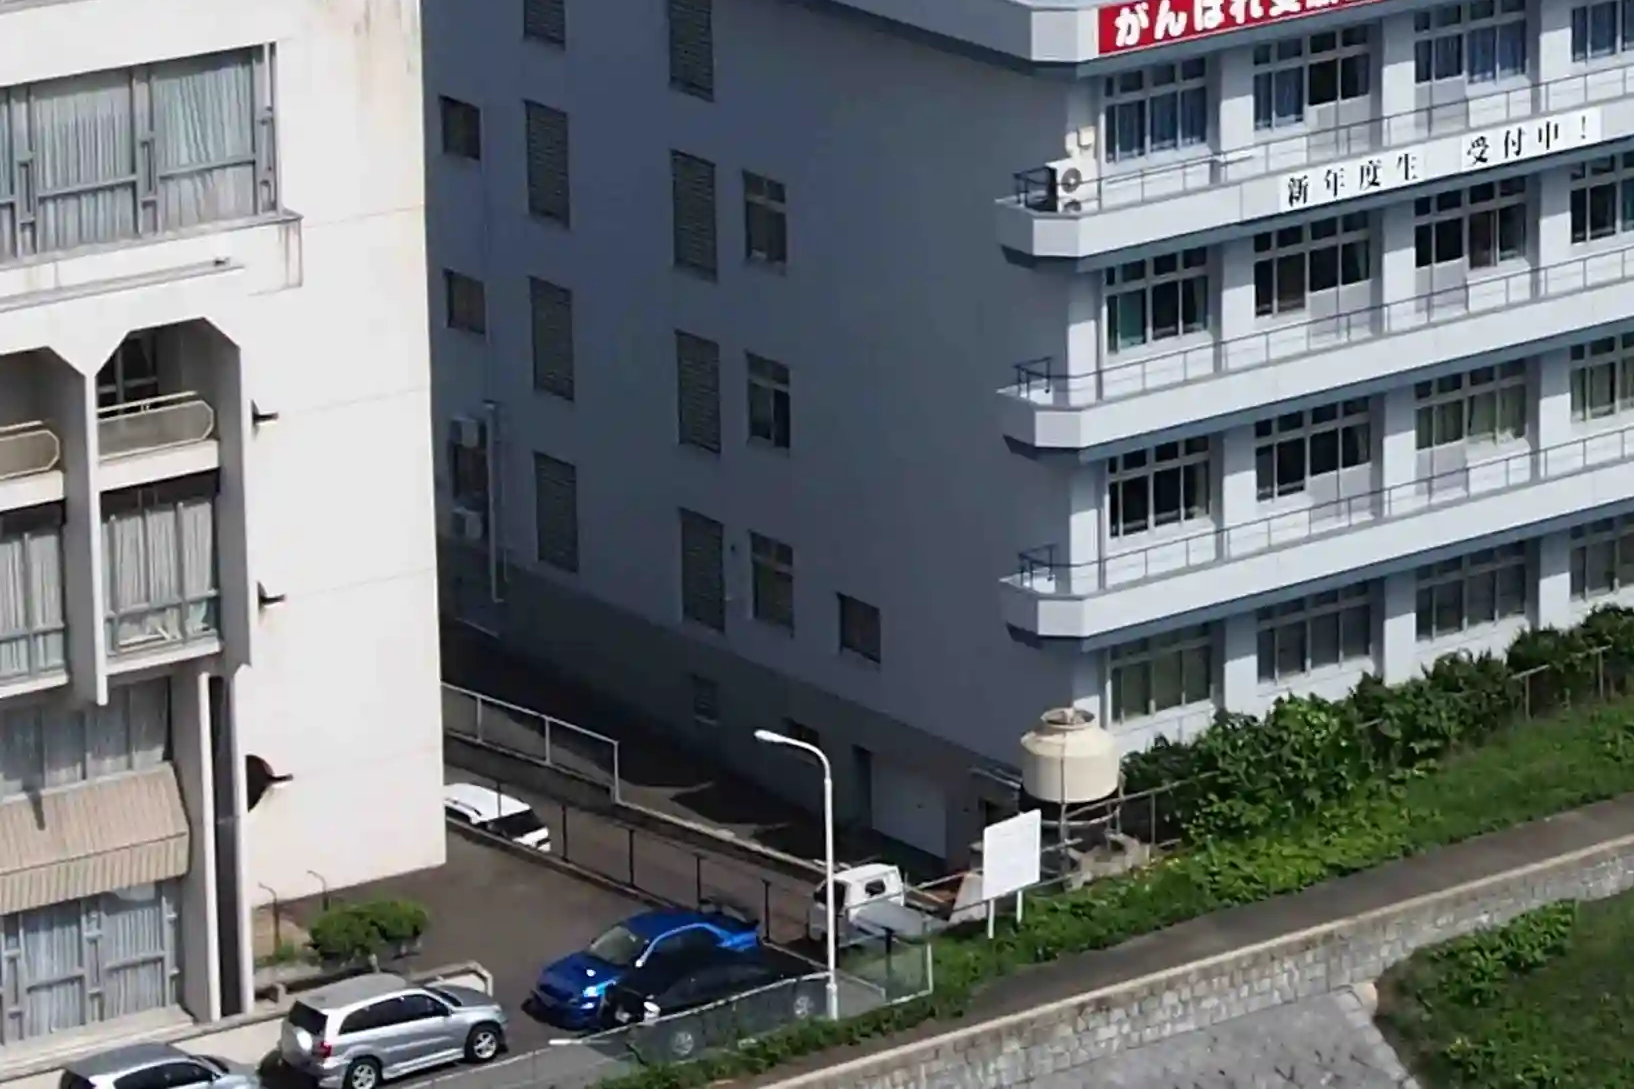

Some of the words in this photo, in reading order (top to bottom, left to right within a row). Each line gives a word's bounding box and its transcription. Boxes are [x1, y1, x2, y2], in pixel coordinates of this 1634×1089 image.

[1287, 153, 1419, 207] 新年度生
[1466, 115, 1588, 164] 受付中！
